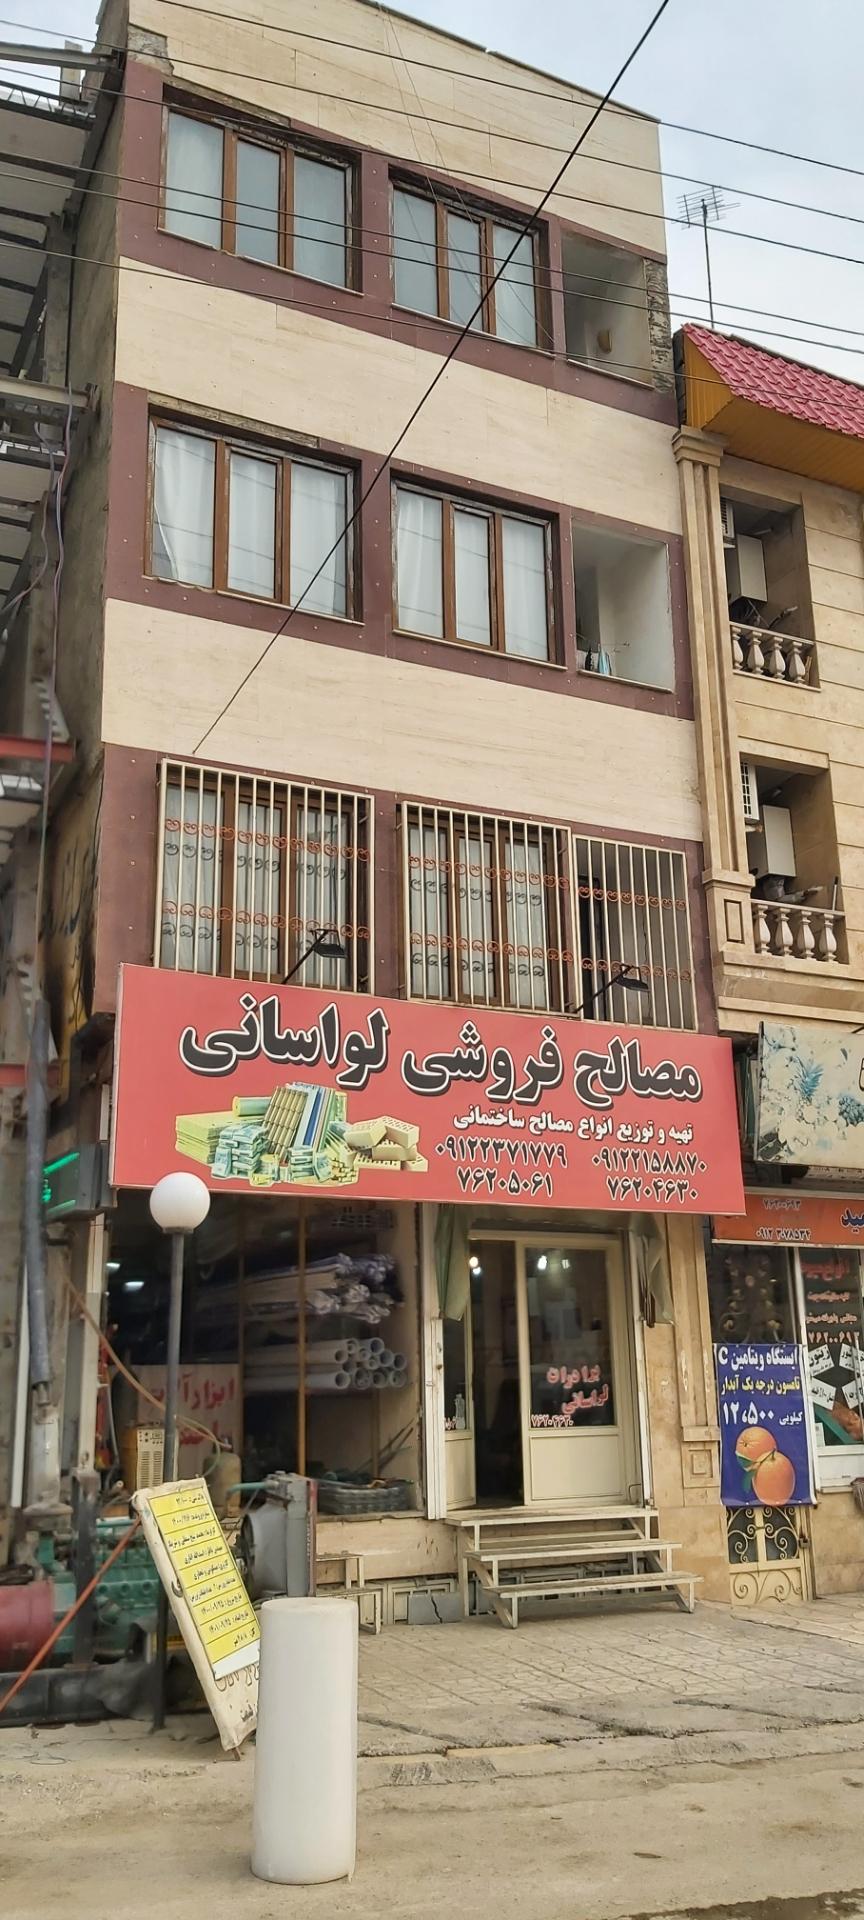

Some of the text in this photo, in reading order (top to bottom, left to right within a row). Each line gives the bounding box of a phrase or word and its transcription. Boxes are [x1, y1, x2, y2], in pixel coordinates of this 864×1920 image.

[179, 993, 702, 1110] مصالح فروشی لواسانی
[453, 1105, 693, 1145] تهیه و توزیع انواع مصالح ساختمانی
[435, 1135, 707, 1174] ۰۹۱۲۲۳۷۱۷۷۹ ۰۹۱۲۲۱۵۸۸۷۰
[457, 1166, 699, 1203] ۷۶۲۰۵۰۶۱ ۷۶۲۰۴۶۳۰
[718, 1346, 728, 1365] C
[731, 1344, 765, 1371] ویتامین
[766, 1344, 798, 1370] ایستگاه
[721, 1374, 740, 1396] آبدار
[741, 1375, 754, 1394] یک
[755, 1379, 774, 1395] درجه
[779, 1411, 803, 1426] کیلویی
